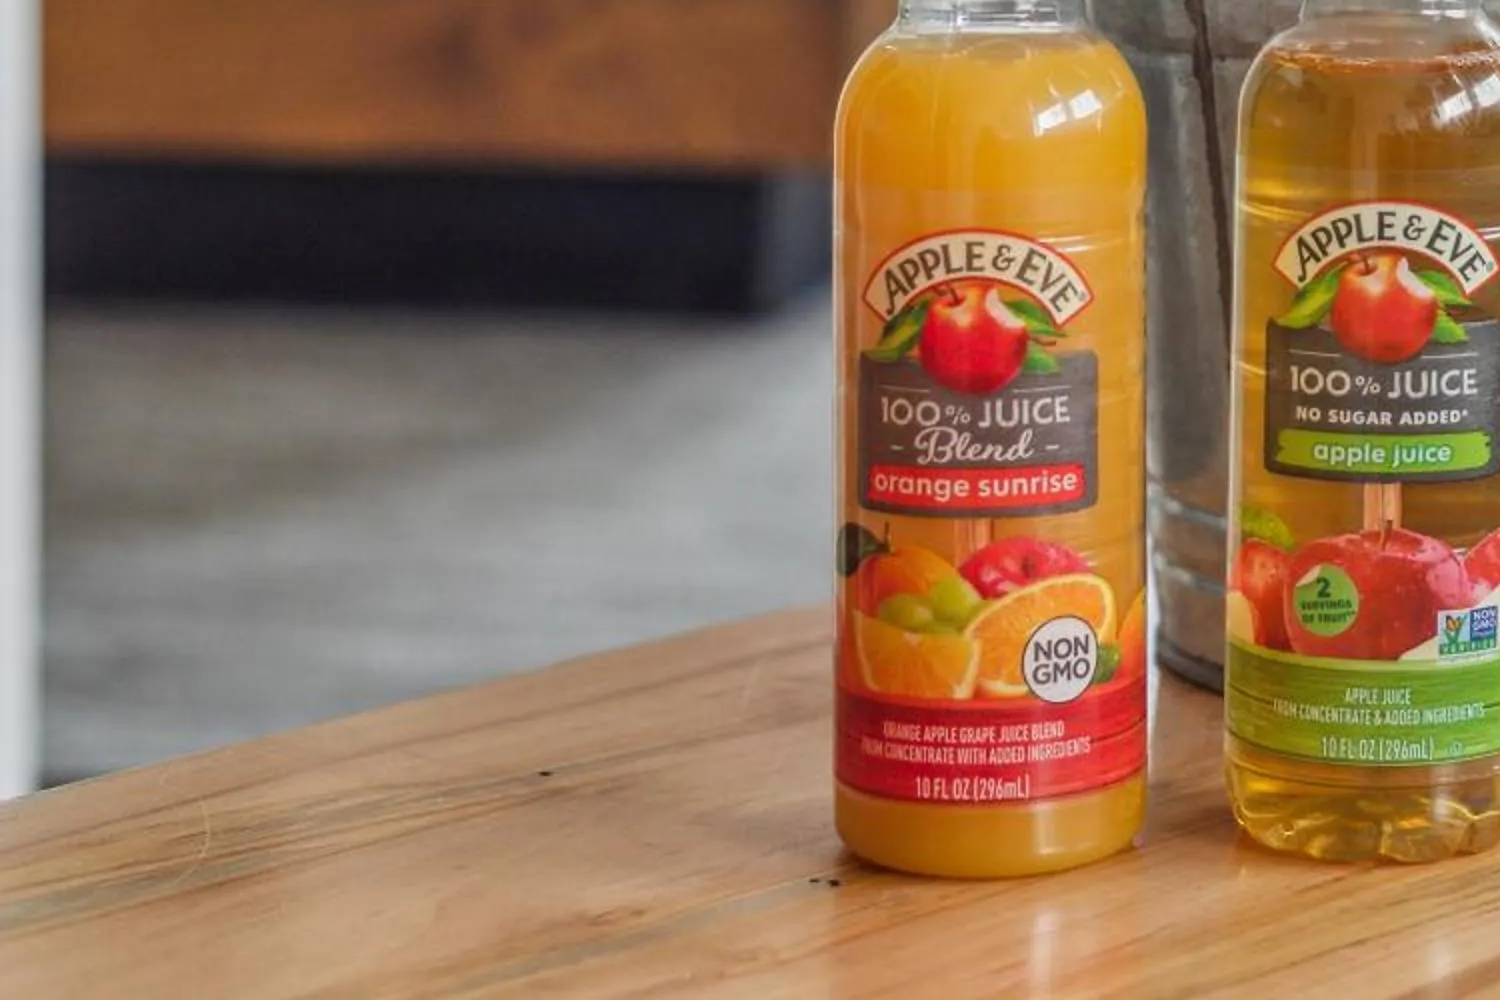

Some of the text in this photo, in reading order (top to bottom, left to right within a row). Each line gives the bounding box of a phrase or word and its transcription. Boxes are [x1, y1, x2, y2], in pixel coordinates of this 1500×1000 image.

[1297, 211, 1487, 283] APPLE & EVE
[884, 241, 1079, 315] APPLE & EVE
[1290, 365, 1478, 400] 100% JUICE
[880, 395, 1071, 428] 100% JUICE
[1296, 406, 1321, 423] NO
[1327, 408, 1393, 426] SUGAR
[914, 426, 1034, 464] Blend
[1313, 440, 1452, 468] apple juice
[873, 469, 1078, 502] orange sunrise
[1316, 577, 1331, 598] 2
[1473, 608, 1496, 621] NON
[1033, 633, 1090, 662] NON
[1032, 661, 1091, 685] GMO
[1345, 687, 1411, 705] APPLE JUICE
[1299, 704, 1371, 725] CONCENTRATE
[1383, 709, 1420, 725] ADDED
[923, 725, 957, 743] APPLE
[959, 726, 996, 743] GRAPE
[999, 725, 1029, 743] JUICE
[1031, 720, 1065, 741] BLEND
[885, 741, 955, 765] CONCENTRATE
[956, 747, 987, 765] WITH
[989, 746, 1025, 764] ADDED
[1027, 735, 1091, 762] INGREDIENTS
[1322, 736, 1337, 758] 10
[1339, 737, 1355, 760] FL
[1359, 738, 1376, 761] OZ
[916, 775, 931, 799] 10
[933, 777, 950, 800] FL
[952, 777, 970, 801] OZ
